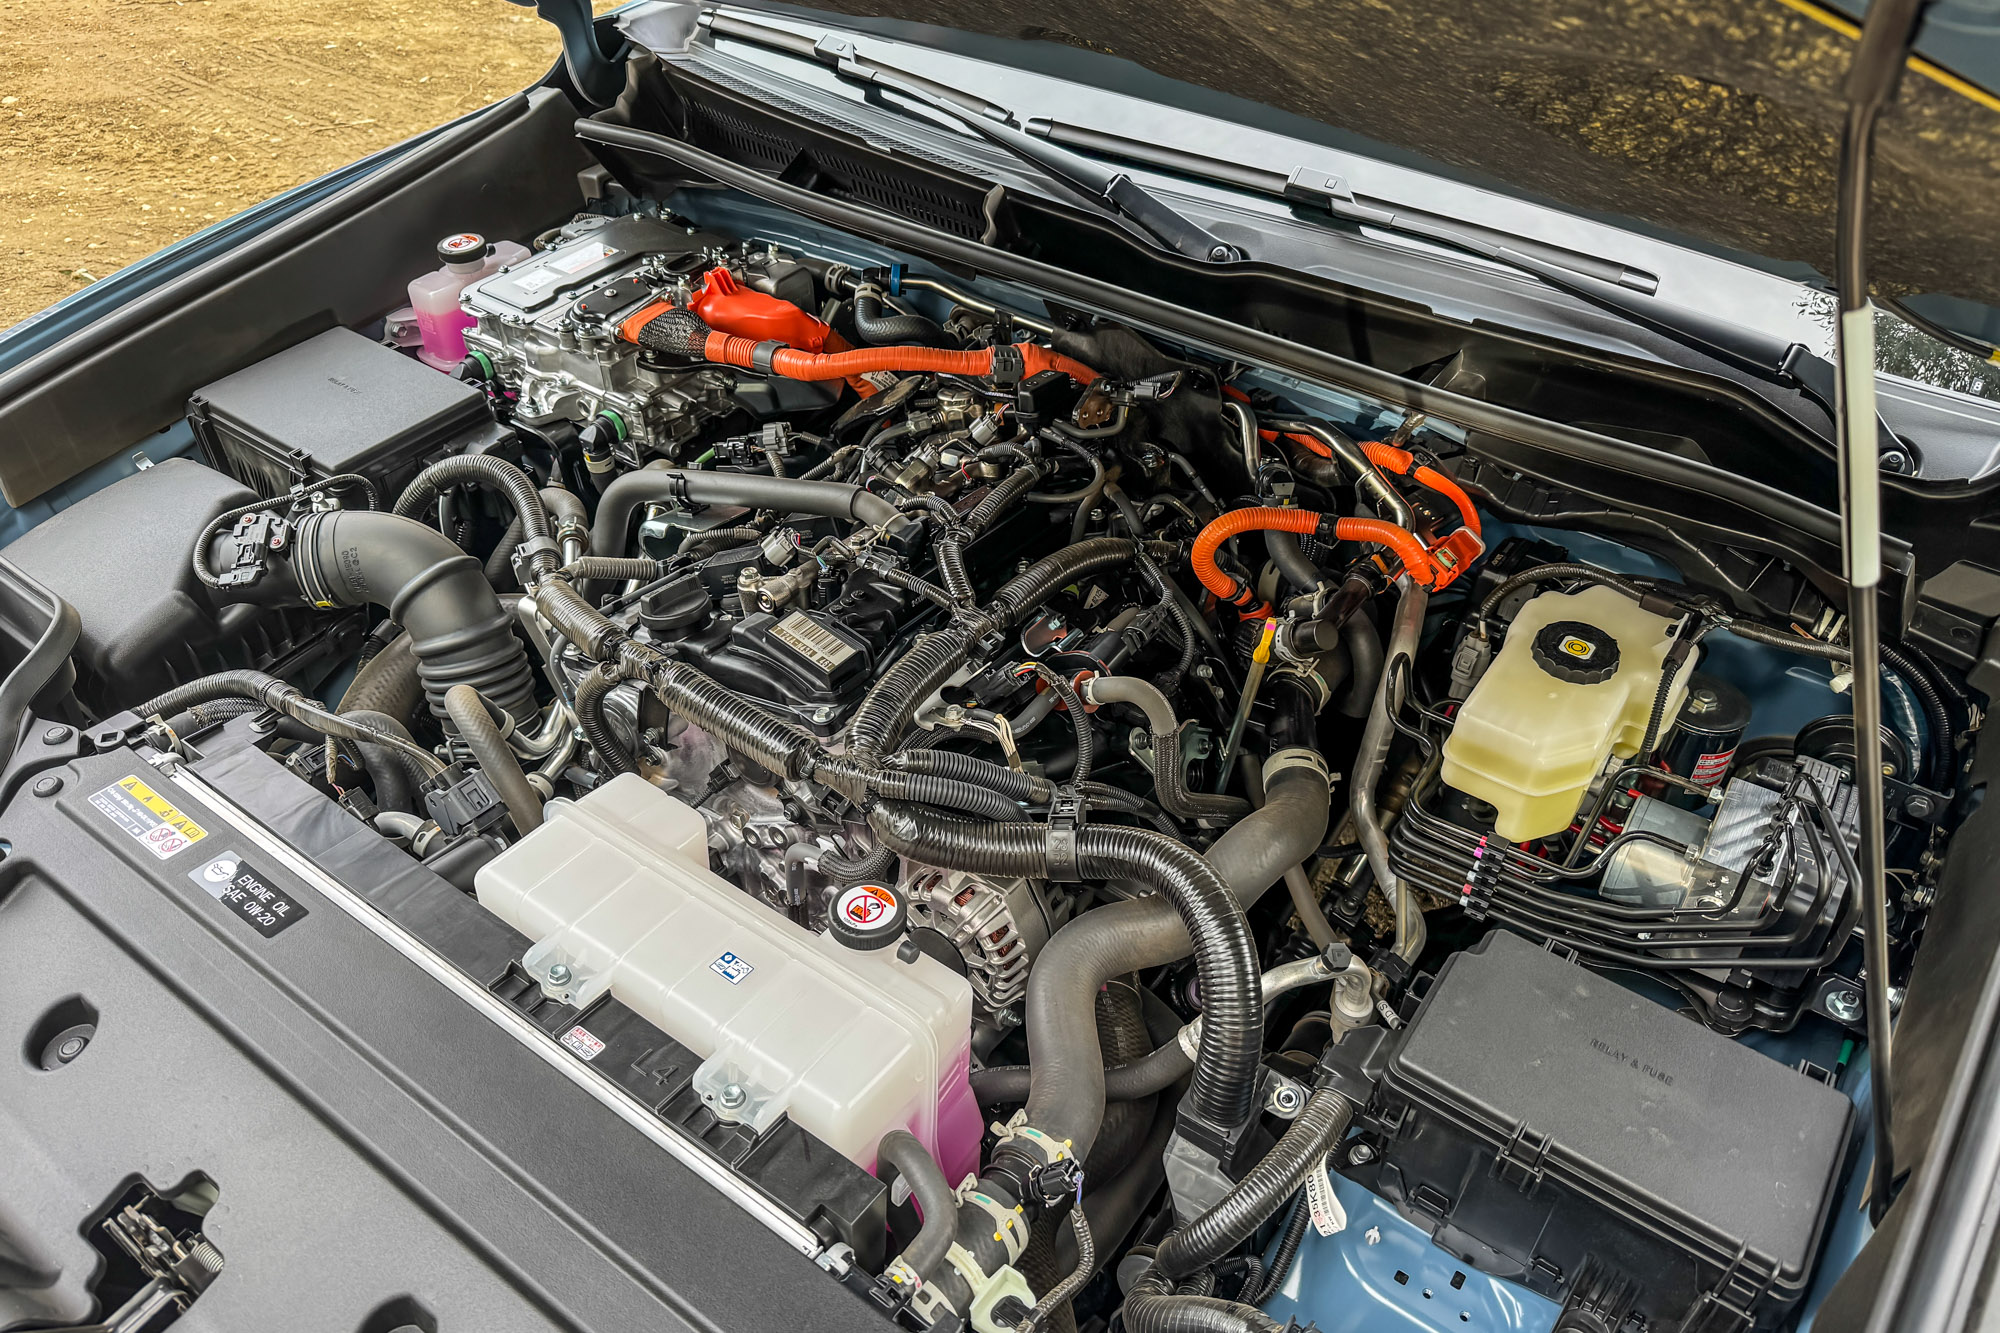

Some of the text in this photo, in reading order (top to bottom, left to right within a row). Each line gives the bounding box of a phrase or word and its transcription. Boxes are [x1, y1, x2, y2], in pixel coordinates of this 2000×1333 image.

[222, 883, 276, 926] SAE 0W-20
[238, 874, 290, 917] ENGINE OIL
[630, 1048, 679, 1086] L4
